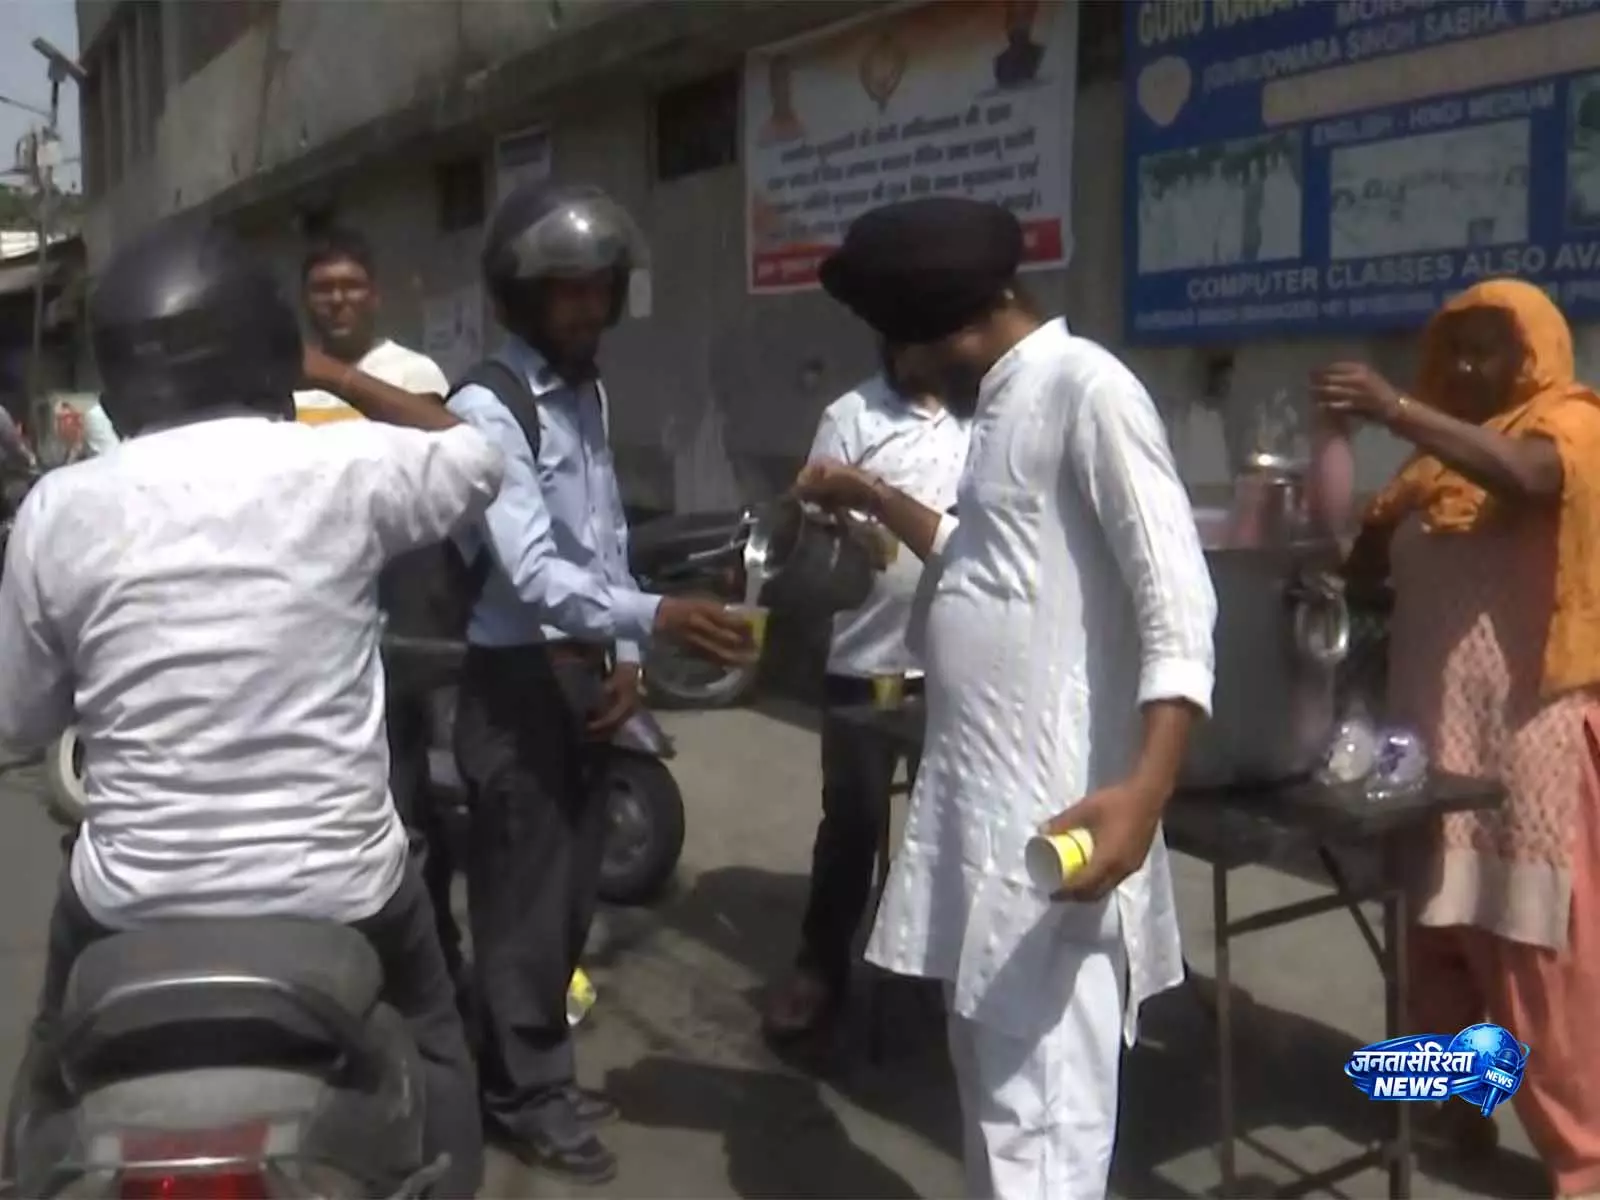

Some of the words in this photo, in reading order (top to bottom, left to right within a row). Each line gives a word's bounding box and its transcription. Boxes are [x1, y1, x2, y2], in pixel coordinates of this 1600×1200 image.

[1186, 266, 1319, 301] COMPUTER
[1327, 253, 1455, 290] CLASSES
[1461, 245, 1546, 278] ALSO
